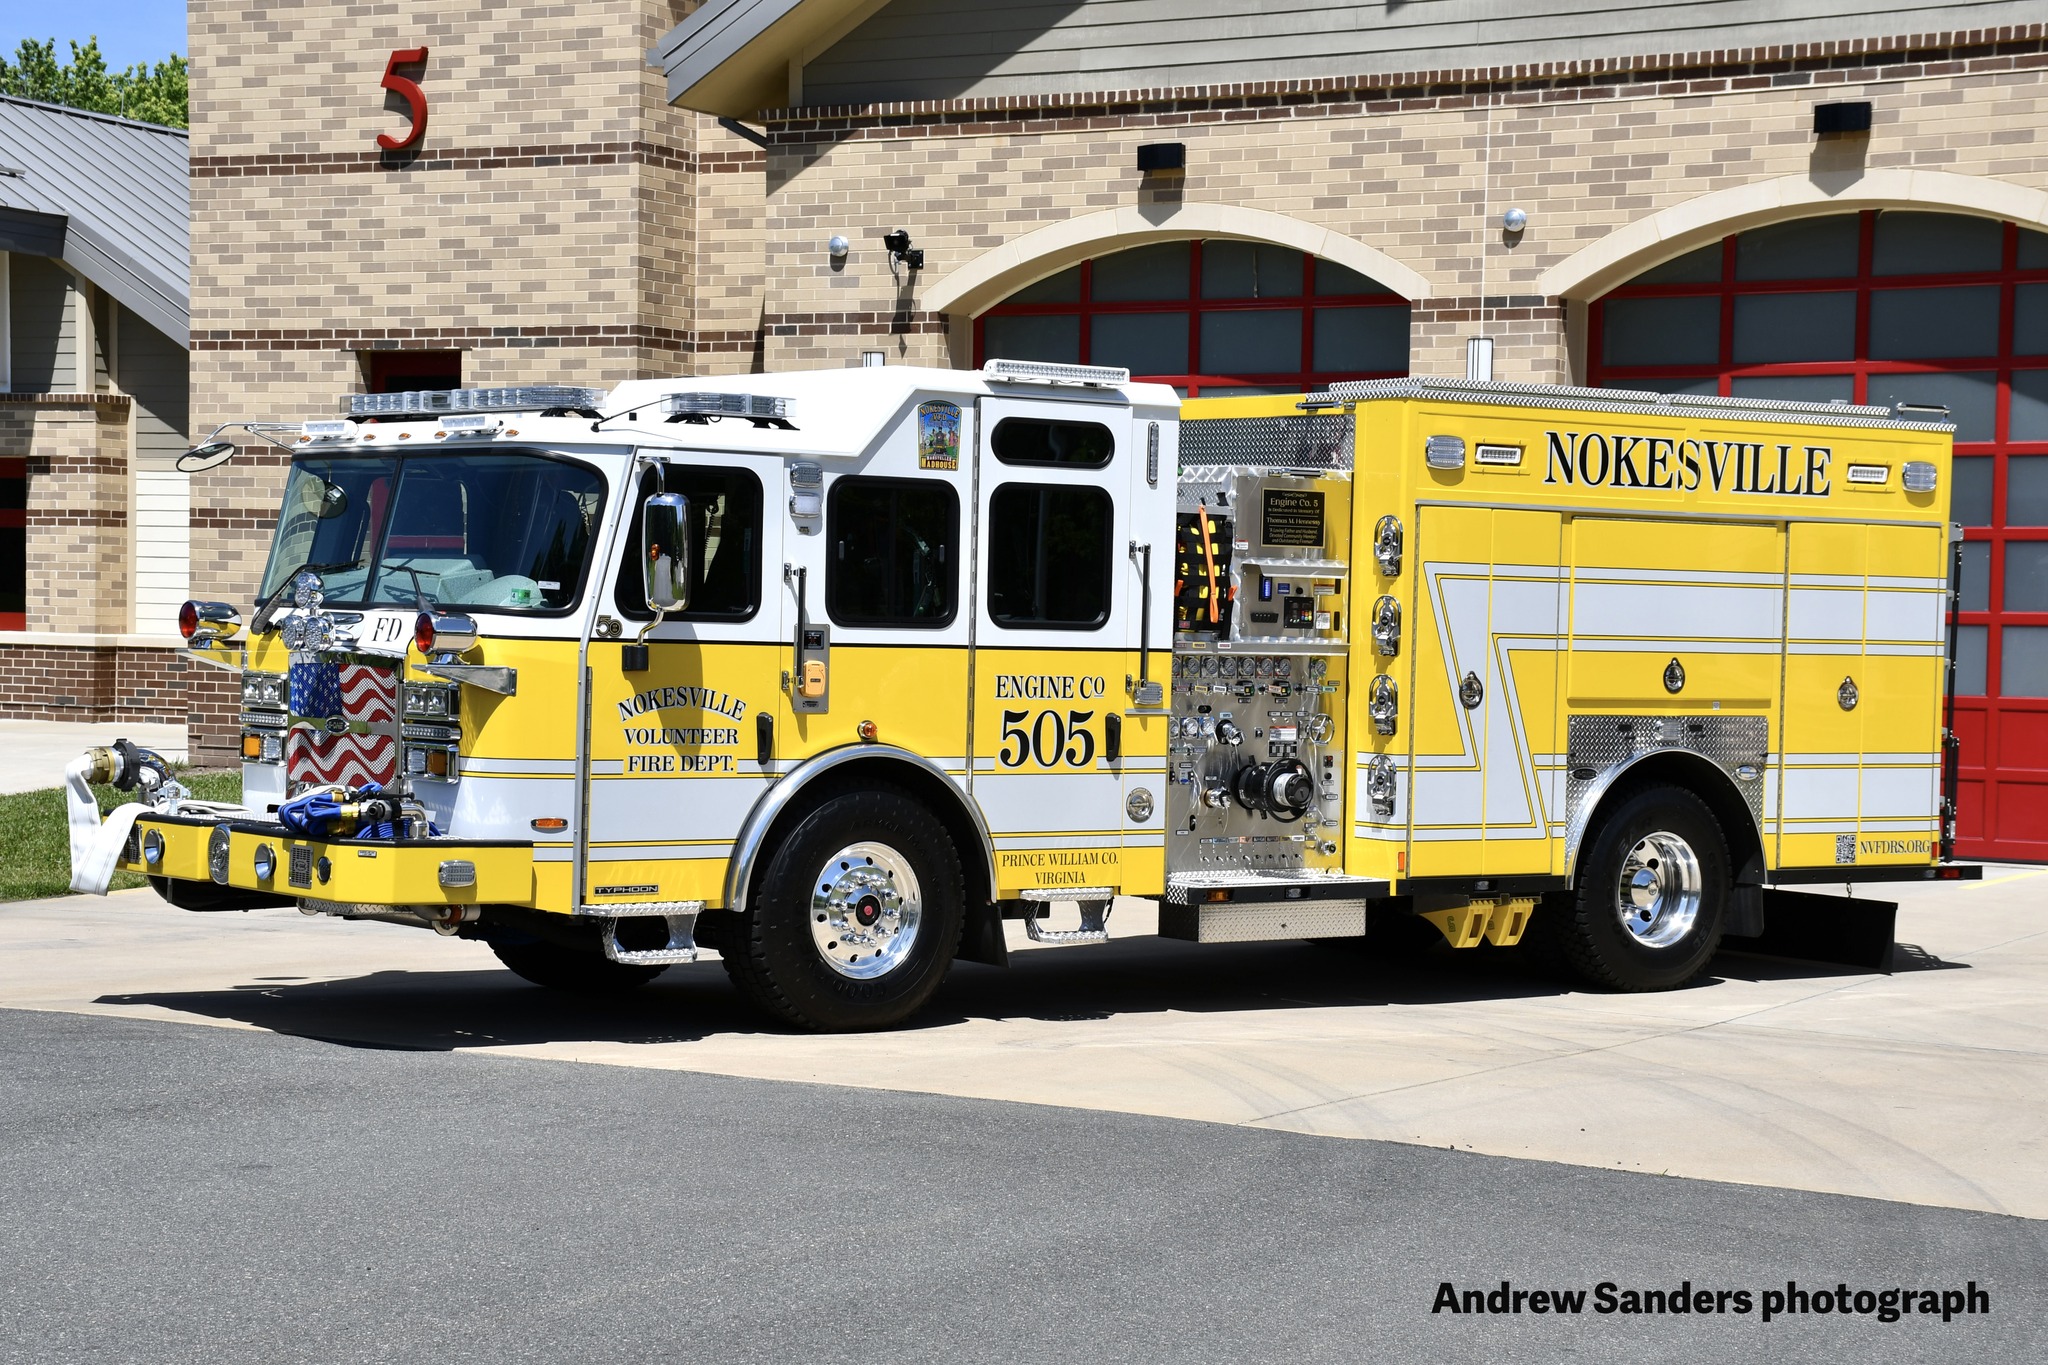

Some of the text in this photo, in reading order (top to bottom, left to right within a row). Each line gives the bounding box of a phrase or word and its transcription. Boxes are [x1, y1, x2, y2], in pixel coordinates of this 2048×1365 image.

[377, 46, 428, 149] 5
[920, 405, 960, 419] NOKESVILLE
[921, 457, 956, 469] MADHOUSE
[1544, 431, 1831, 496] NOKESVILLE
[1270, 498, 1318, 507] Engine Co. 5
[995, 675, 1075, 699] ENGINE
[617, 686, 747, 722] NOKESVILLE
[624, 728, 739, 745] VOLUNTEER
[999, 709, 1095, 768] 505
[627, 755, 734, 772] FIRE DEPT.
[1859, 840, 1931, 854] NVFDRS.ORG
[1002, 851, 1119, 867] PRINCE WILLIAM CO.
[1035, 871, 1086, 885] VIRGINIA
[595, 886, 658, 894] TYPHOON
